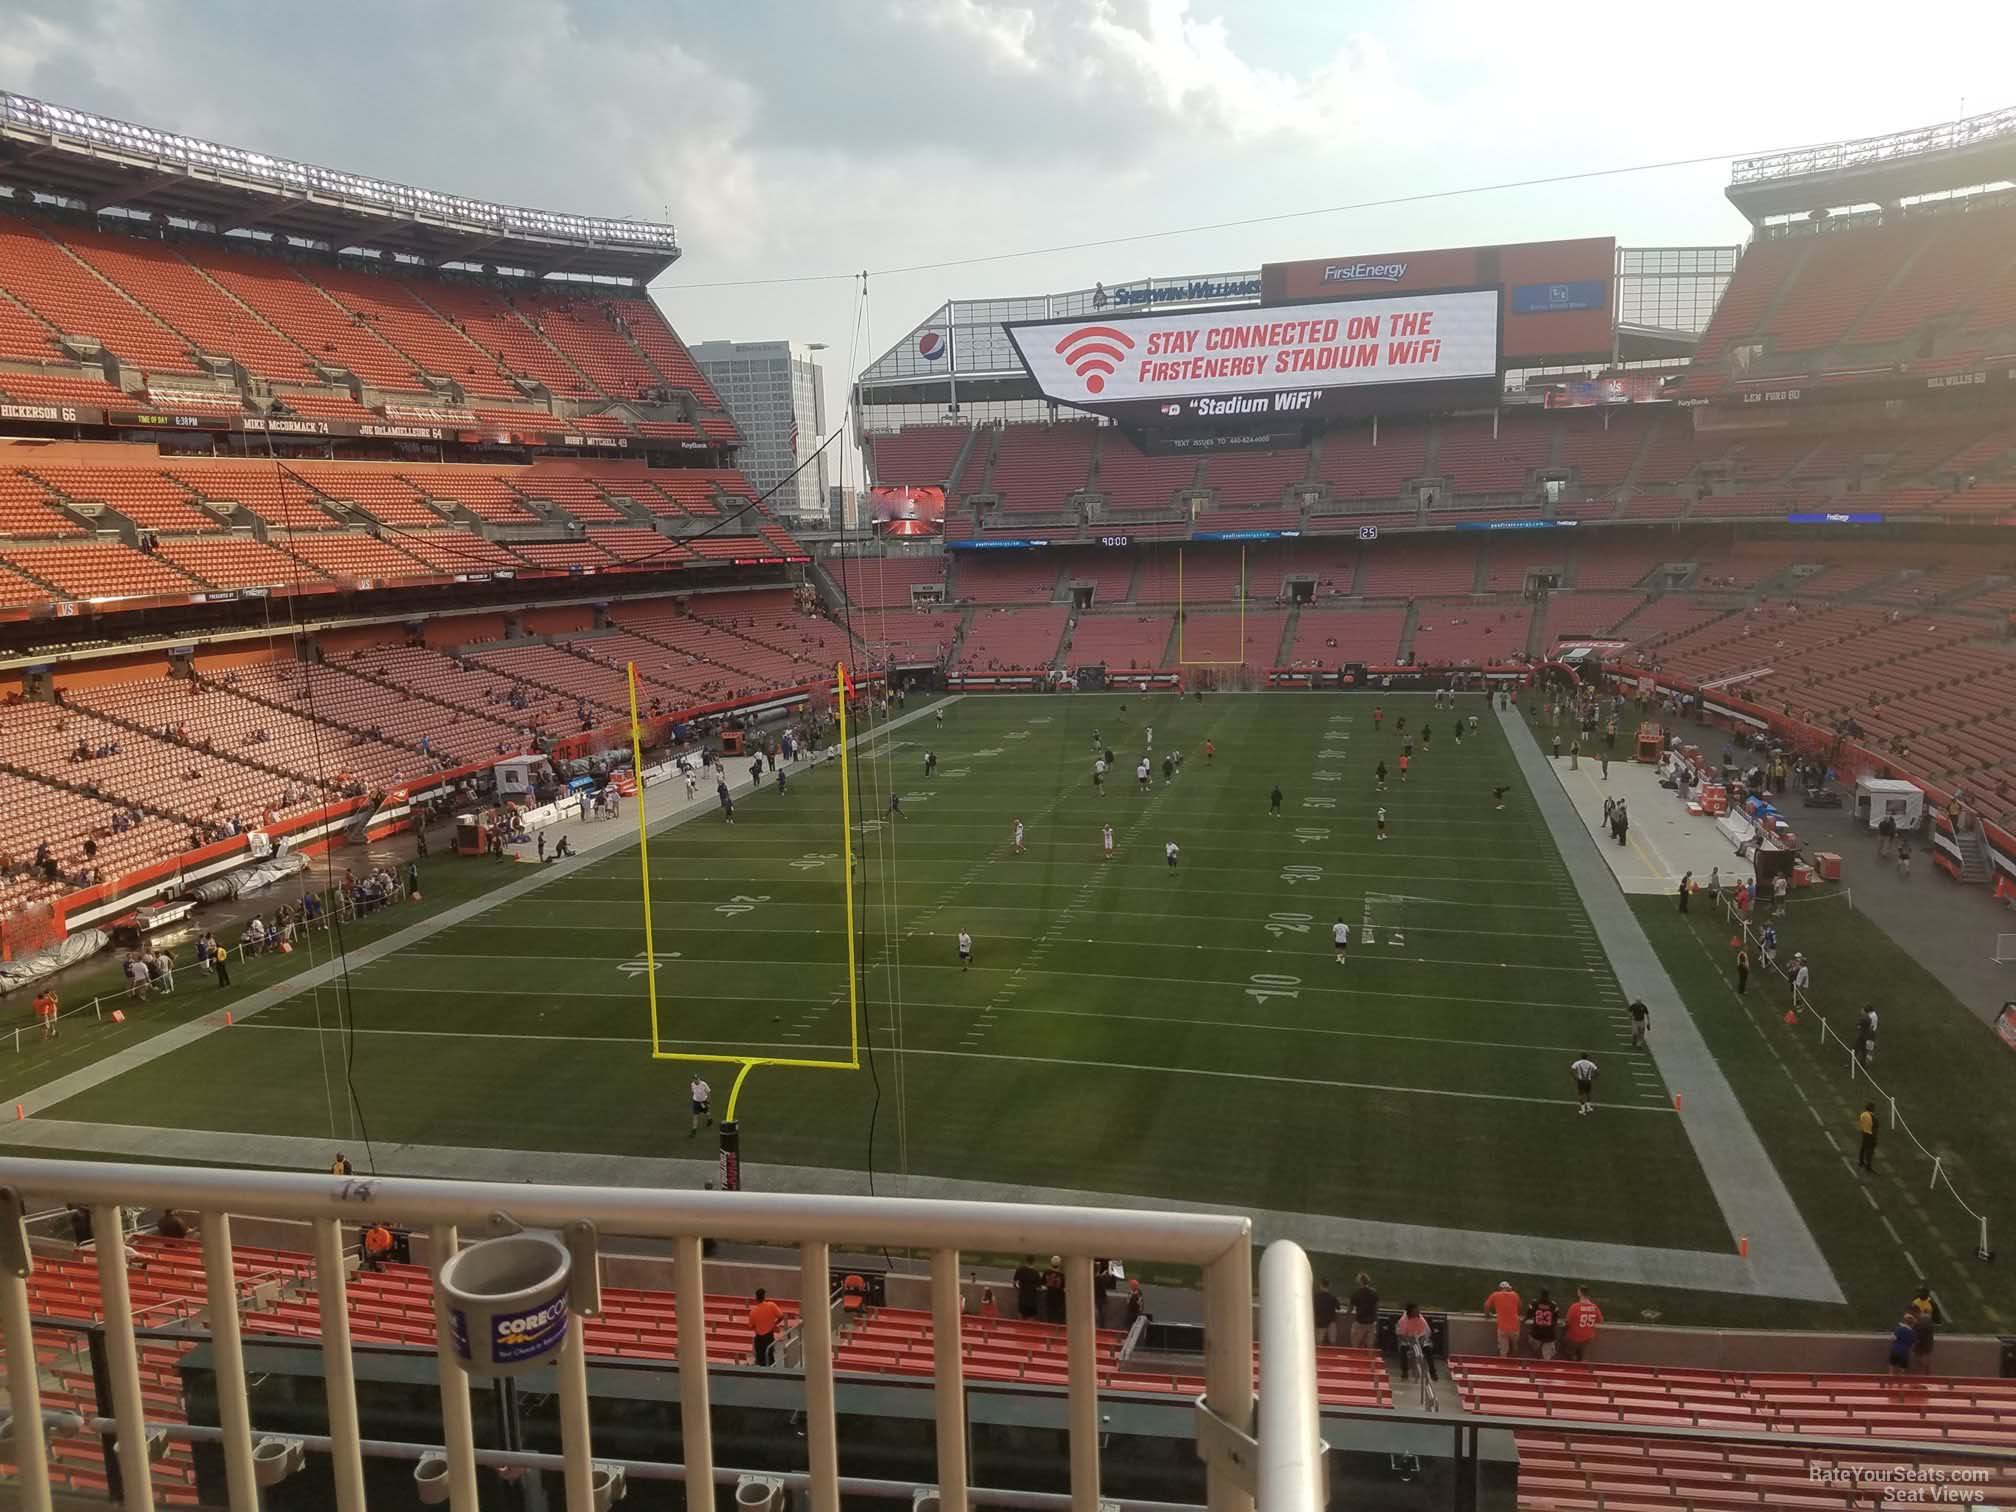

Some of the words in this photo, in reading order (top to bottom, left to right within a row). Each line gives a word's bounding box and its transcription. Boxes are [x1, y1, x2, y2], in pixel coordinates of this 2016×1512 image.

[1324, 262, 1408, 281] FirstEnergy
[1147, 330, 1199, 355] STAY
[1206, 318, 1338, 351] CONNECTED
[1346, 315, 1381, 340] ON
[1390, 311, 1433, 337] THE
[1275, 343, 1379, 373] STADIUM
[1388, 339, 1441, 366] WiFi
[1678, 397, 1710, 407] KeyBank
[1, 405, 57, 420] HICKERSON
[62, 407, 76, 422] 66
[138, 415, 150, 424] TIME
[157, 415, 168, 424] DAY
[243, 418, 265, 430] MIKE
[317, 422, 329, 434] 74
[360, 425, 373, 435] JOE
[681, 441, 707, 450] KeyBank
[1361, 527, 1375, 538] 25
[60, 603, 74, 617] VS
[1559, 641, 1625, 649] GEICO
[1280, 865, 1323, 881] 30
[714, 895, 771, 913] 20
[1264, 912, 1313, 934] 20
[616, 951, 682, 972] 10
[1245, 974, 1301, 998] 10
